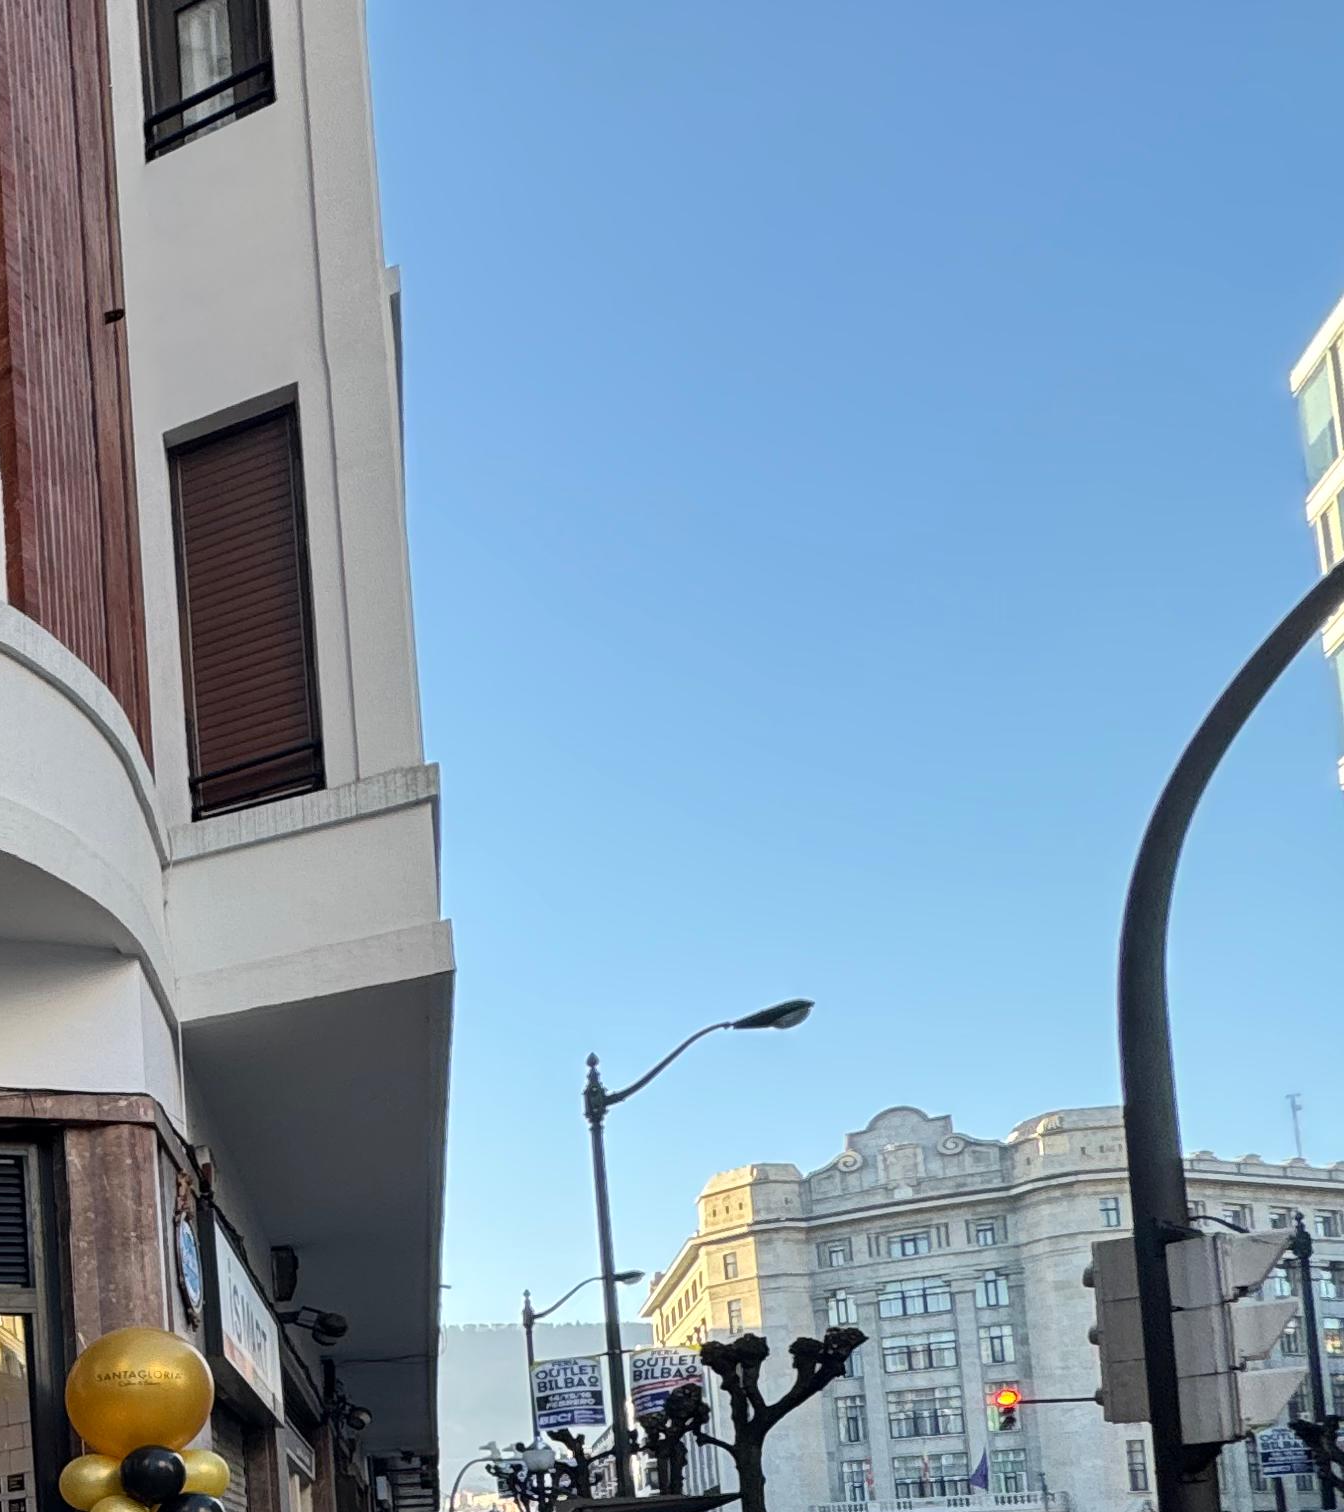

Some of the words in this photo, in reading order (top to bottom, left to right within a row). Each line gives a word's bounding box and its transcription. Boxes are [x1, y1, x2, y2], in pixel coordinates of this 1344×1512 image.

[633, 1354, 698, 1369] OUTLET
[535, 1364, 598, 1380] OUTLET
[633, 1365, 698, 1382] BILBAO
[537, 1376, 599, 1393] BILBAO
